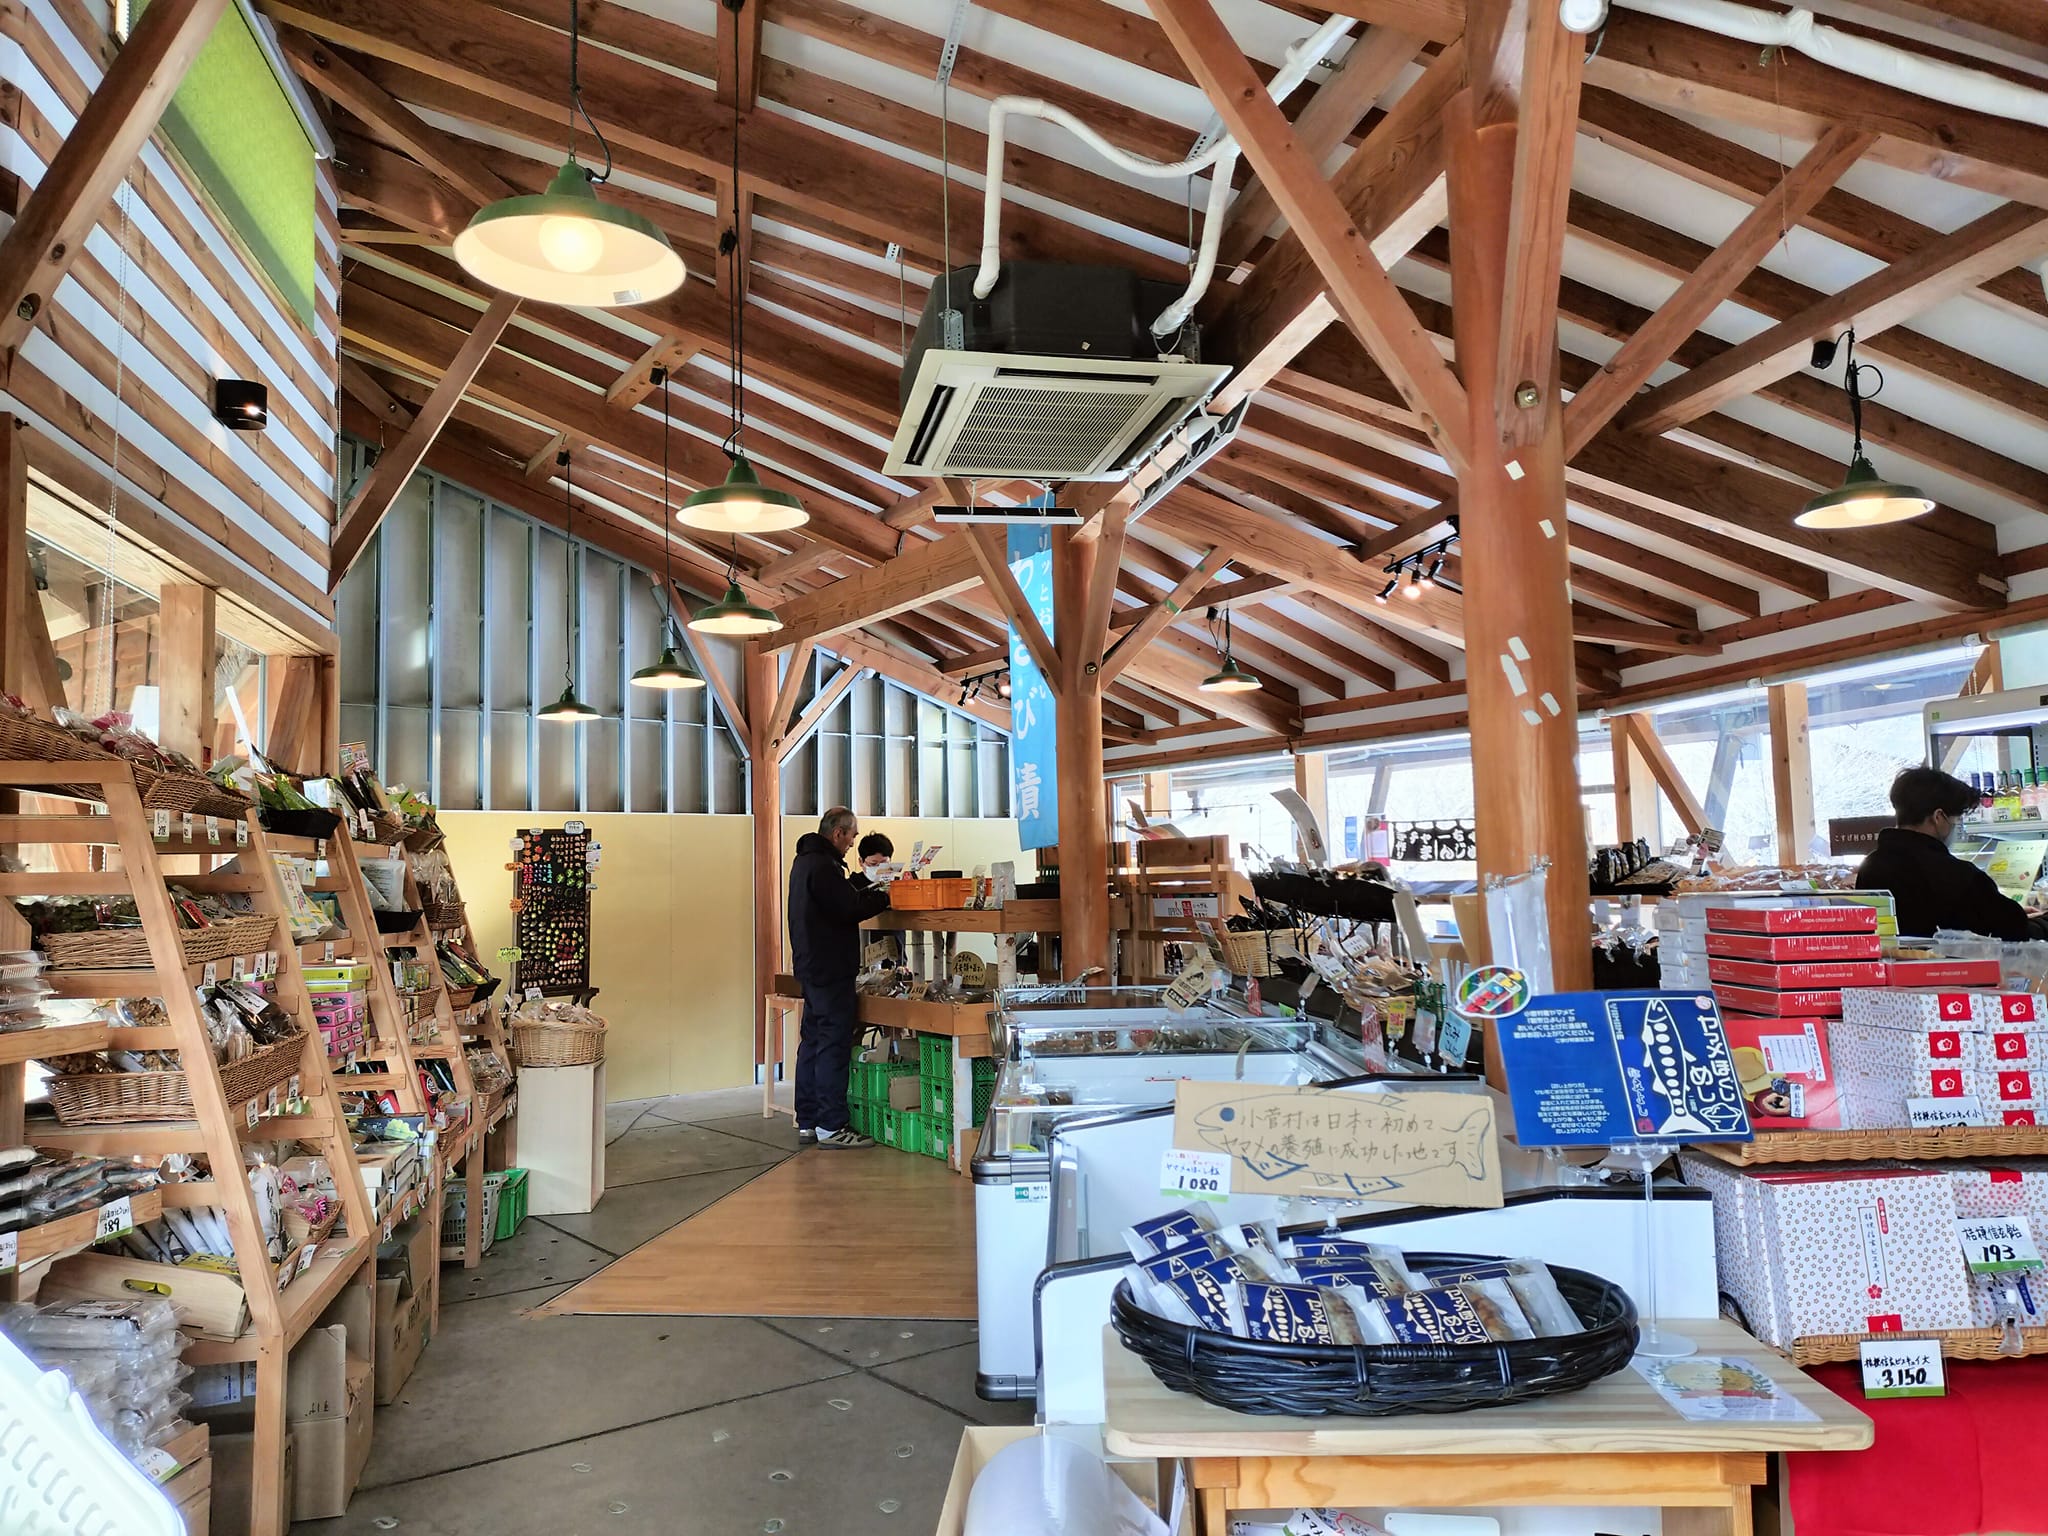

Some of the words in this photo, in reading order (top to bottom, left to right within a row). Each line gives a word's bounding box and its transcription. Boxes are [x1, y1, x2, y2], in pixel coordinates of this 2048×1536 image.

[1697, 1015, 1736, 1102] ヤマメほぐし
[1689, 1065, 1716, 1103] めし
[1240, 1107, 1435, 1135] 小菅村は日本で初めて
[1982, 1244, 2016, 1262] 193
